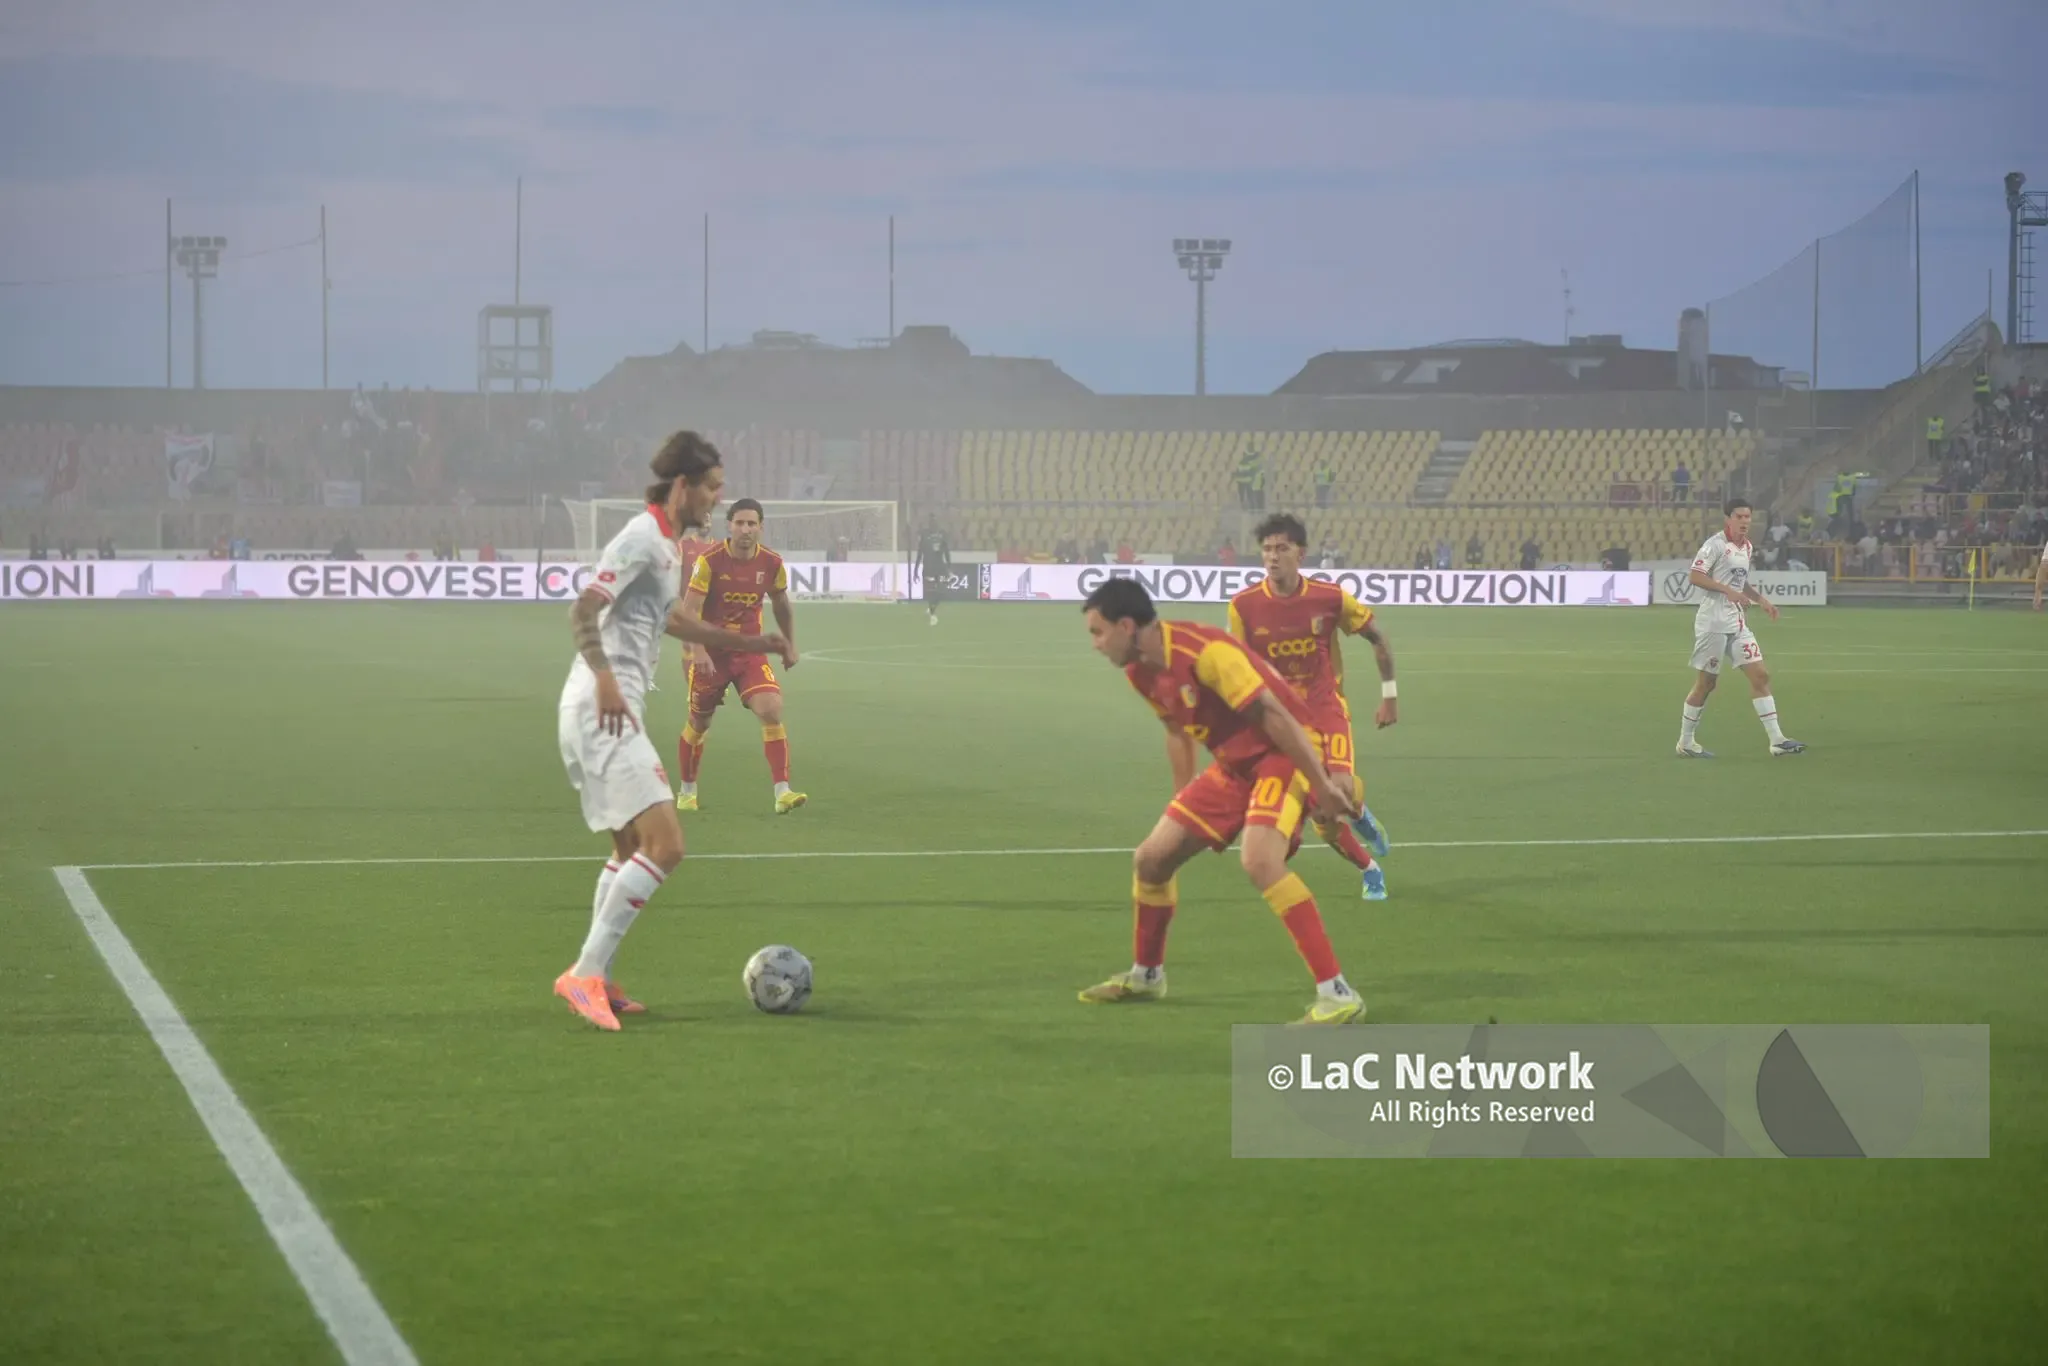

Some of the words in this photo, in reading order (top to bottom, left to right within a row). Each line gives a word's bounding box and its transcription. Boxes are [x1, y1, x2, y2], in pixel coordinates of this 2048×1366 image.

[288, 565, 524, 598] GENOVESE
[1752, 580, 1817, 597] ivenni
[1267, 637, 1317, 658] coop
[1743, 643, 1760, 659] 32
